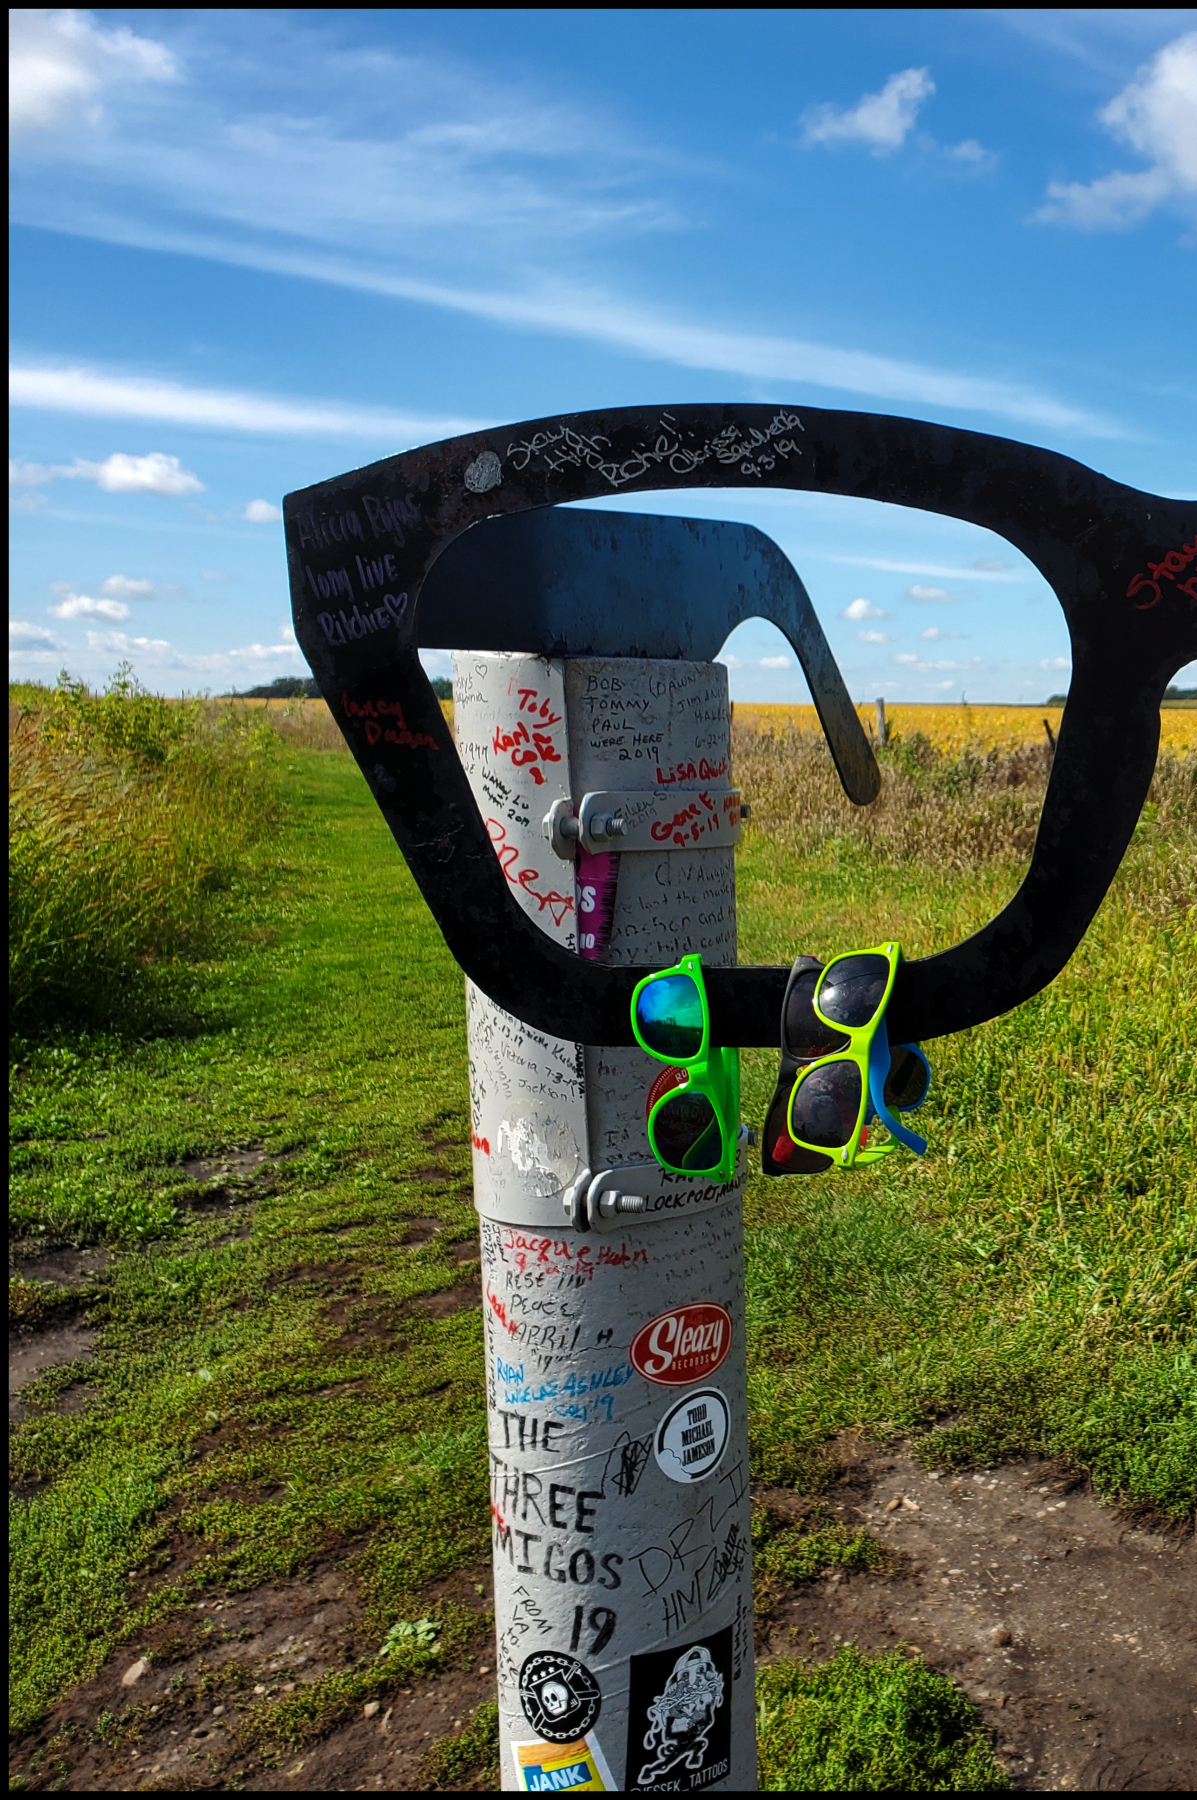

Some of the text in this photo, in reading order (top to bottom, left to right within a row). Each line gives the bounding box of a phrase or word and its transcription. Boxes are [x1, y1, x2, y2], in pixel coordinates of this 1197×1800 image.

[587, 674, 623, 693] BOB
[517, 688, 563, 729] Toby
[581, 695, 650, 714] TOMMY
[590, 731, 664, 750] WERE HERE
[591, 720, 636, 735] PAUL
[618, 746, 661, 765] 2019
[643, 1314, 725, 1375] Sleazy
[496, 1356, 526, 1386] RYAN
[671, 1355, 711, 1372] RECORDS
[560, 1362, 635, 1398] ASHLEY
[686, 1403, 708, 1427] TODD
[498, 1410, 566, 1453] THE
[680, 1419, 715, 1448] MICHAEL
[680, 1437, 716, 1467] JAMESON
[490, 1451, 607, 1534] THREE
[568, 1604, 618, 1657] 19
[528, 1764, 589, 1792] JANK
